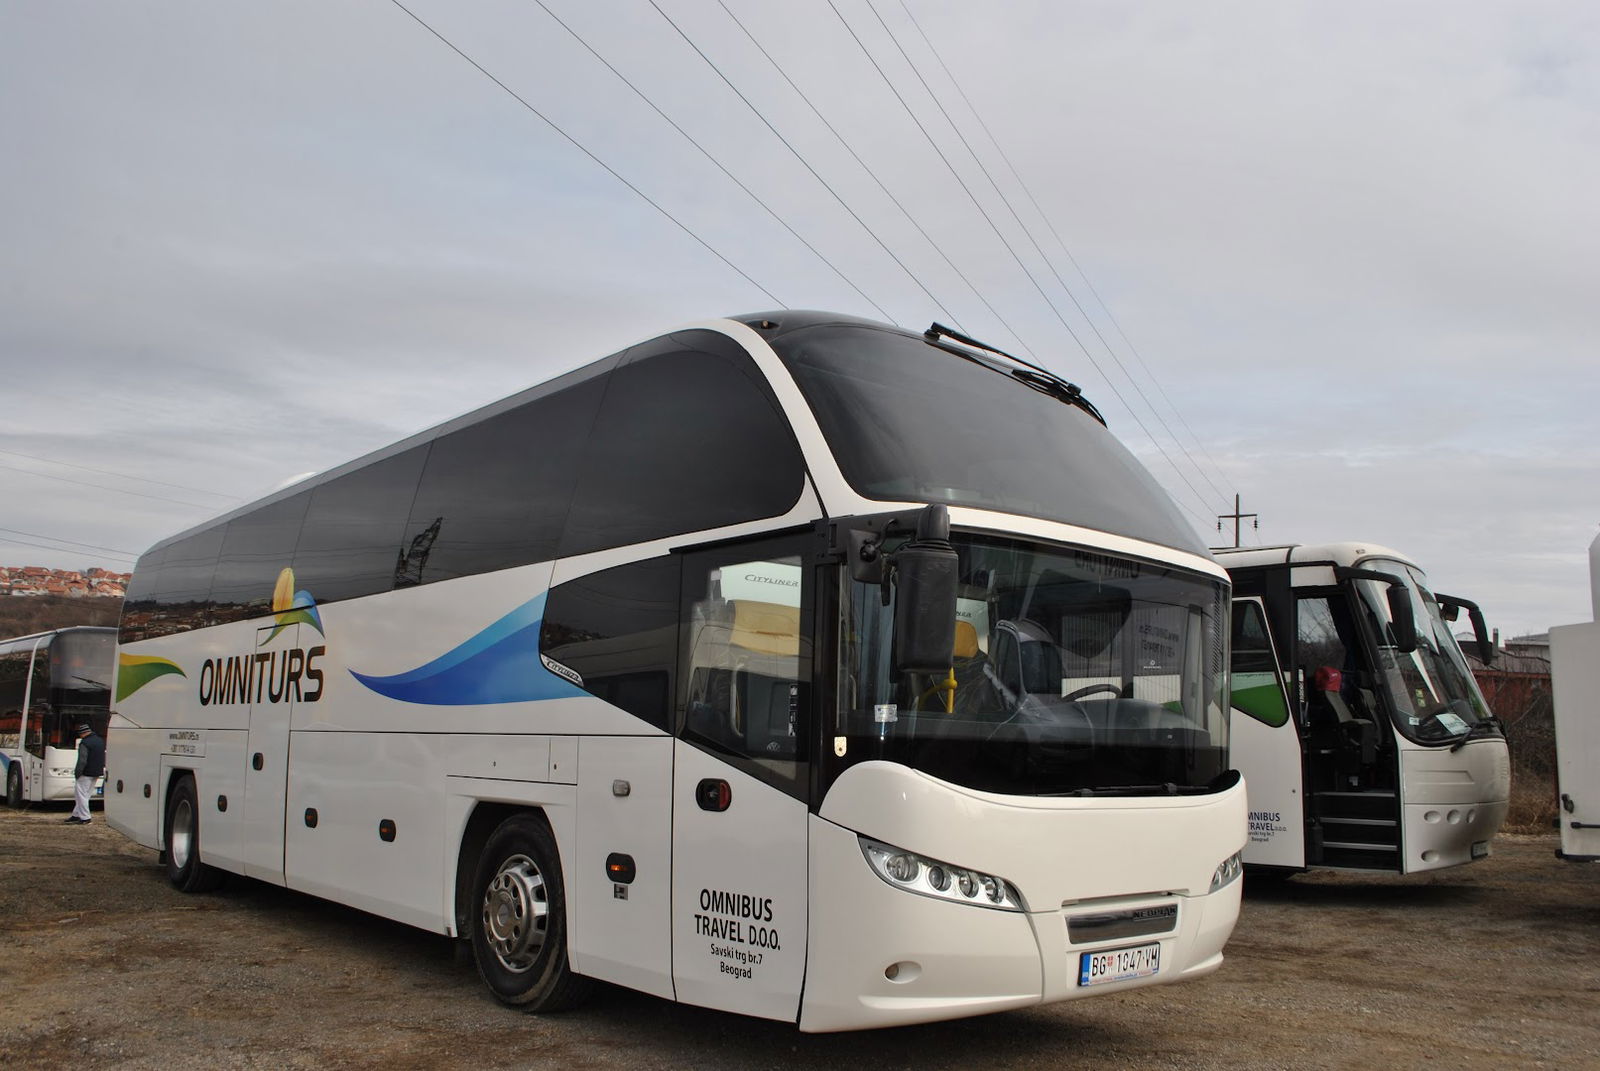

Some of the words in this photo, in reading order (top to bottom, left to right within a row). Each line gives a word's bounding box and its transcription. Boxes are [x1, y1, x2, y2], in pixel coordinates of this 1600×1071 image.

[200, 645, 326, 706] OMNITURS
[1248, 811, 1280, 821] MNIBUS
[700, 888, 773, 922] OMNIBUS
[694, 914, 745, 943] TRAVEL
[749, 925, 781, 950] D.O.O.
[710, 943, 734, 958] Savski
[735, 949, 747, 964] trg
[748, 950, 763, 965] br.7
[720, 961, 752, 979] Beograd
[1091, 956, 1106, 977] BG
